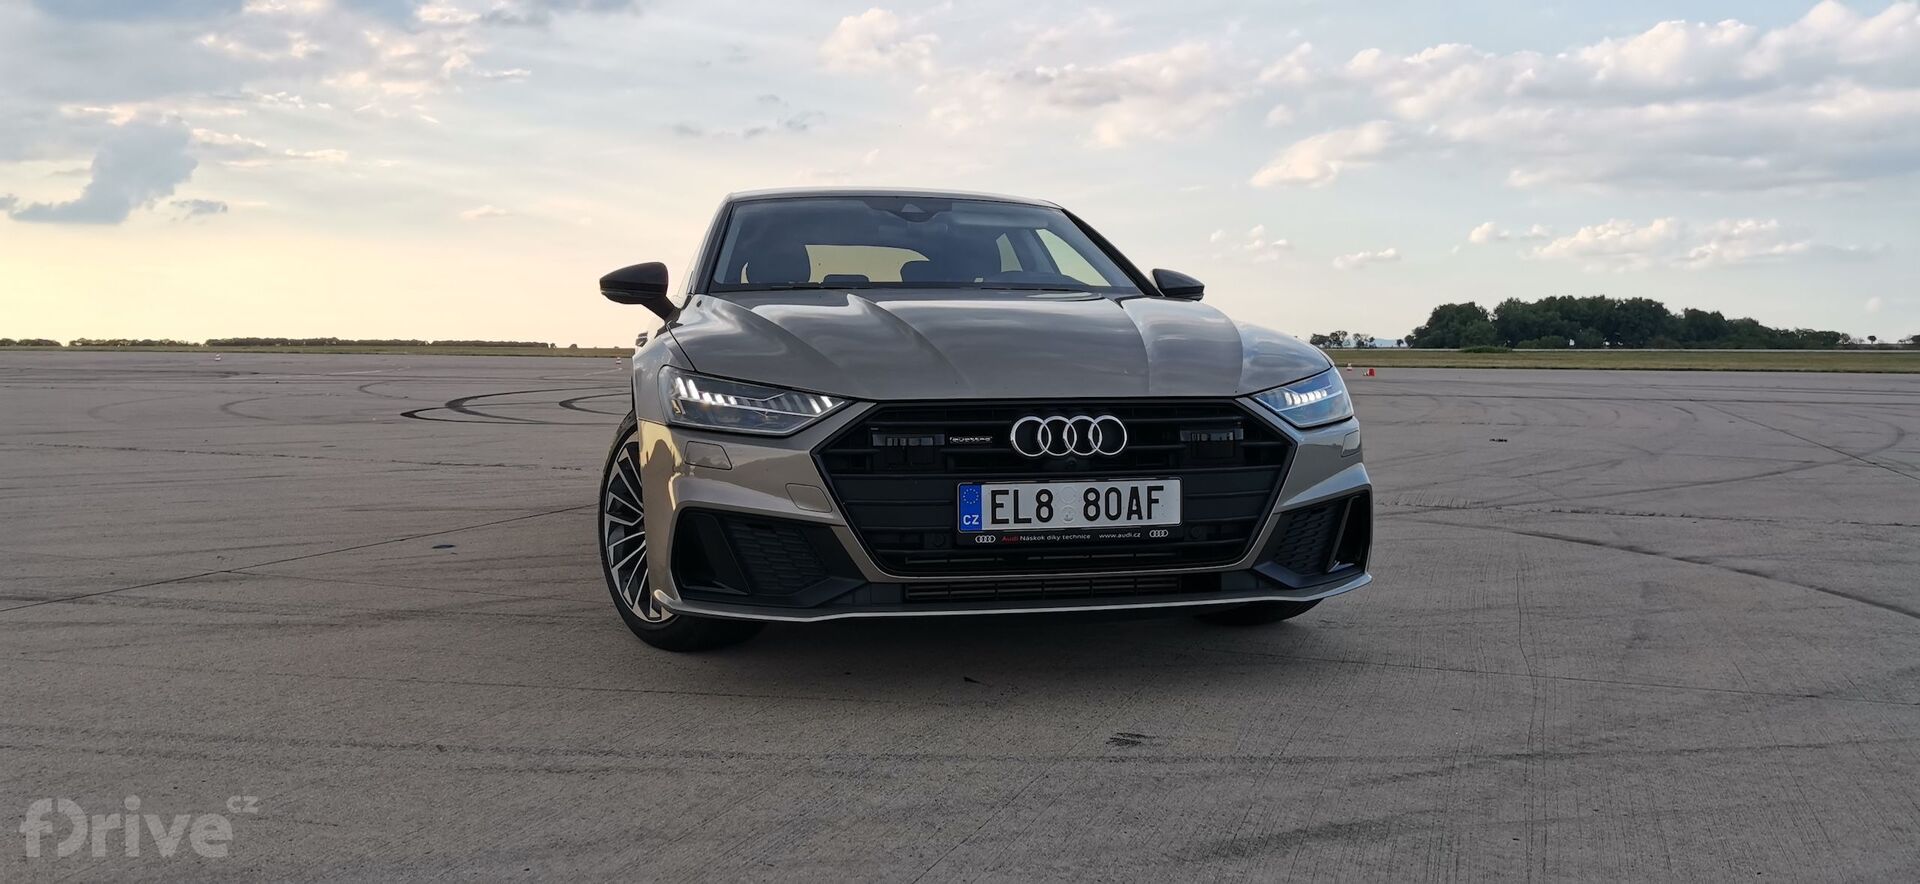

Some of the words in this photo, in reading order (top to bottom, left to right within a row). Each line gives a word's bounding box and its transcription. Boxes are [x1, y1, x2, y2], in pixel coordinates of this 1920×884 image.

[990, 488, 1054, 525] EL8
[1083, 485, 1164, 522] 80AF
[962, 514, 980, 526] CZ
[1062, 533, 1091, 541] technice
